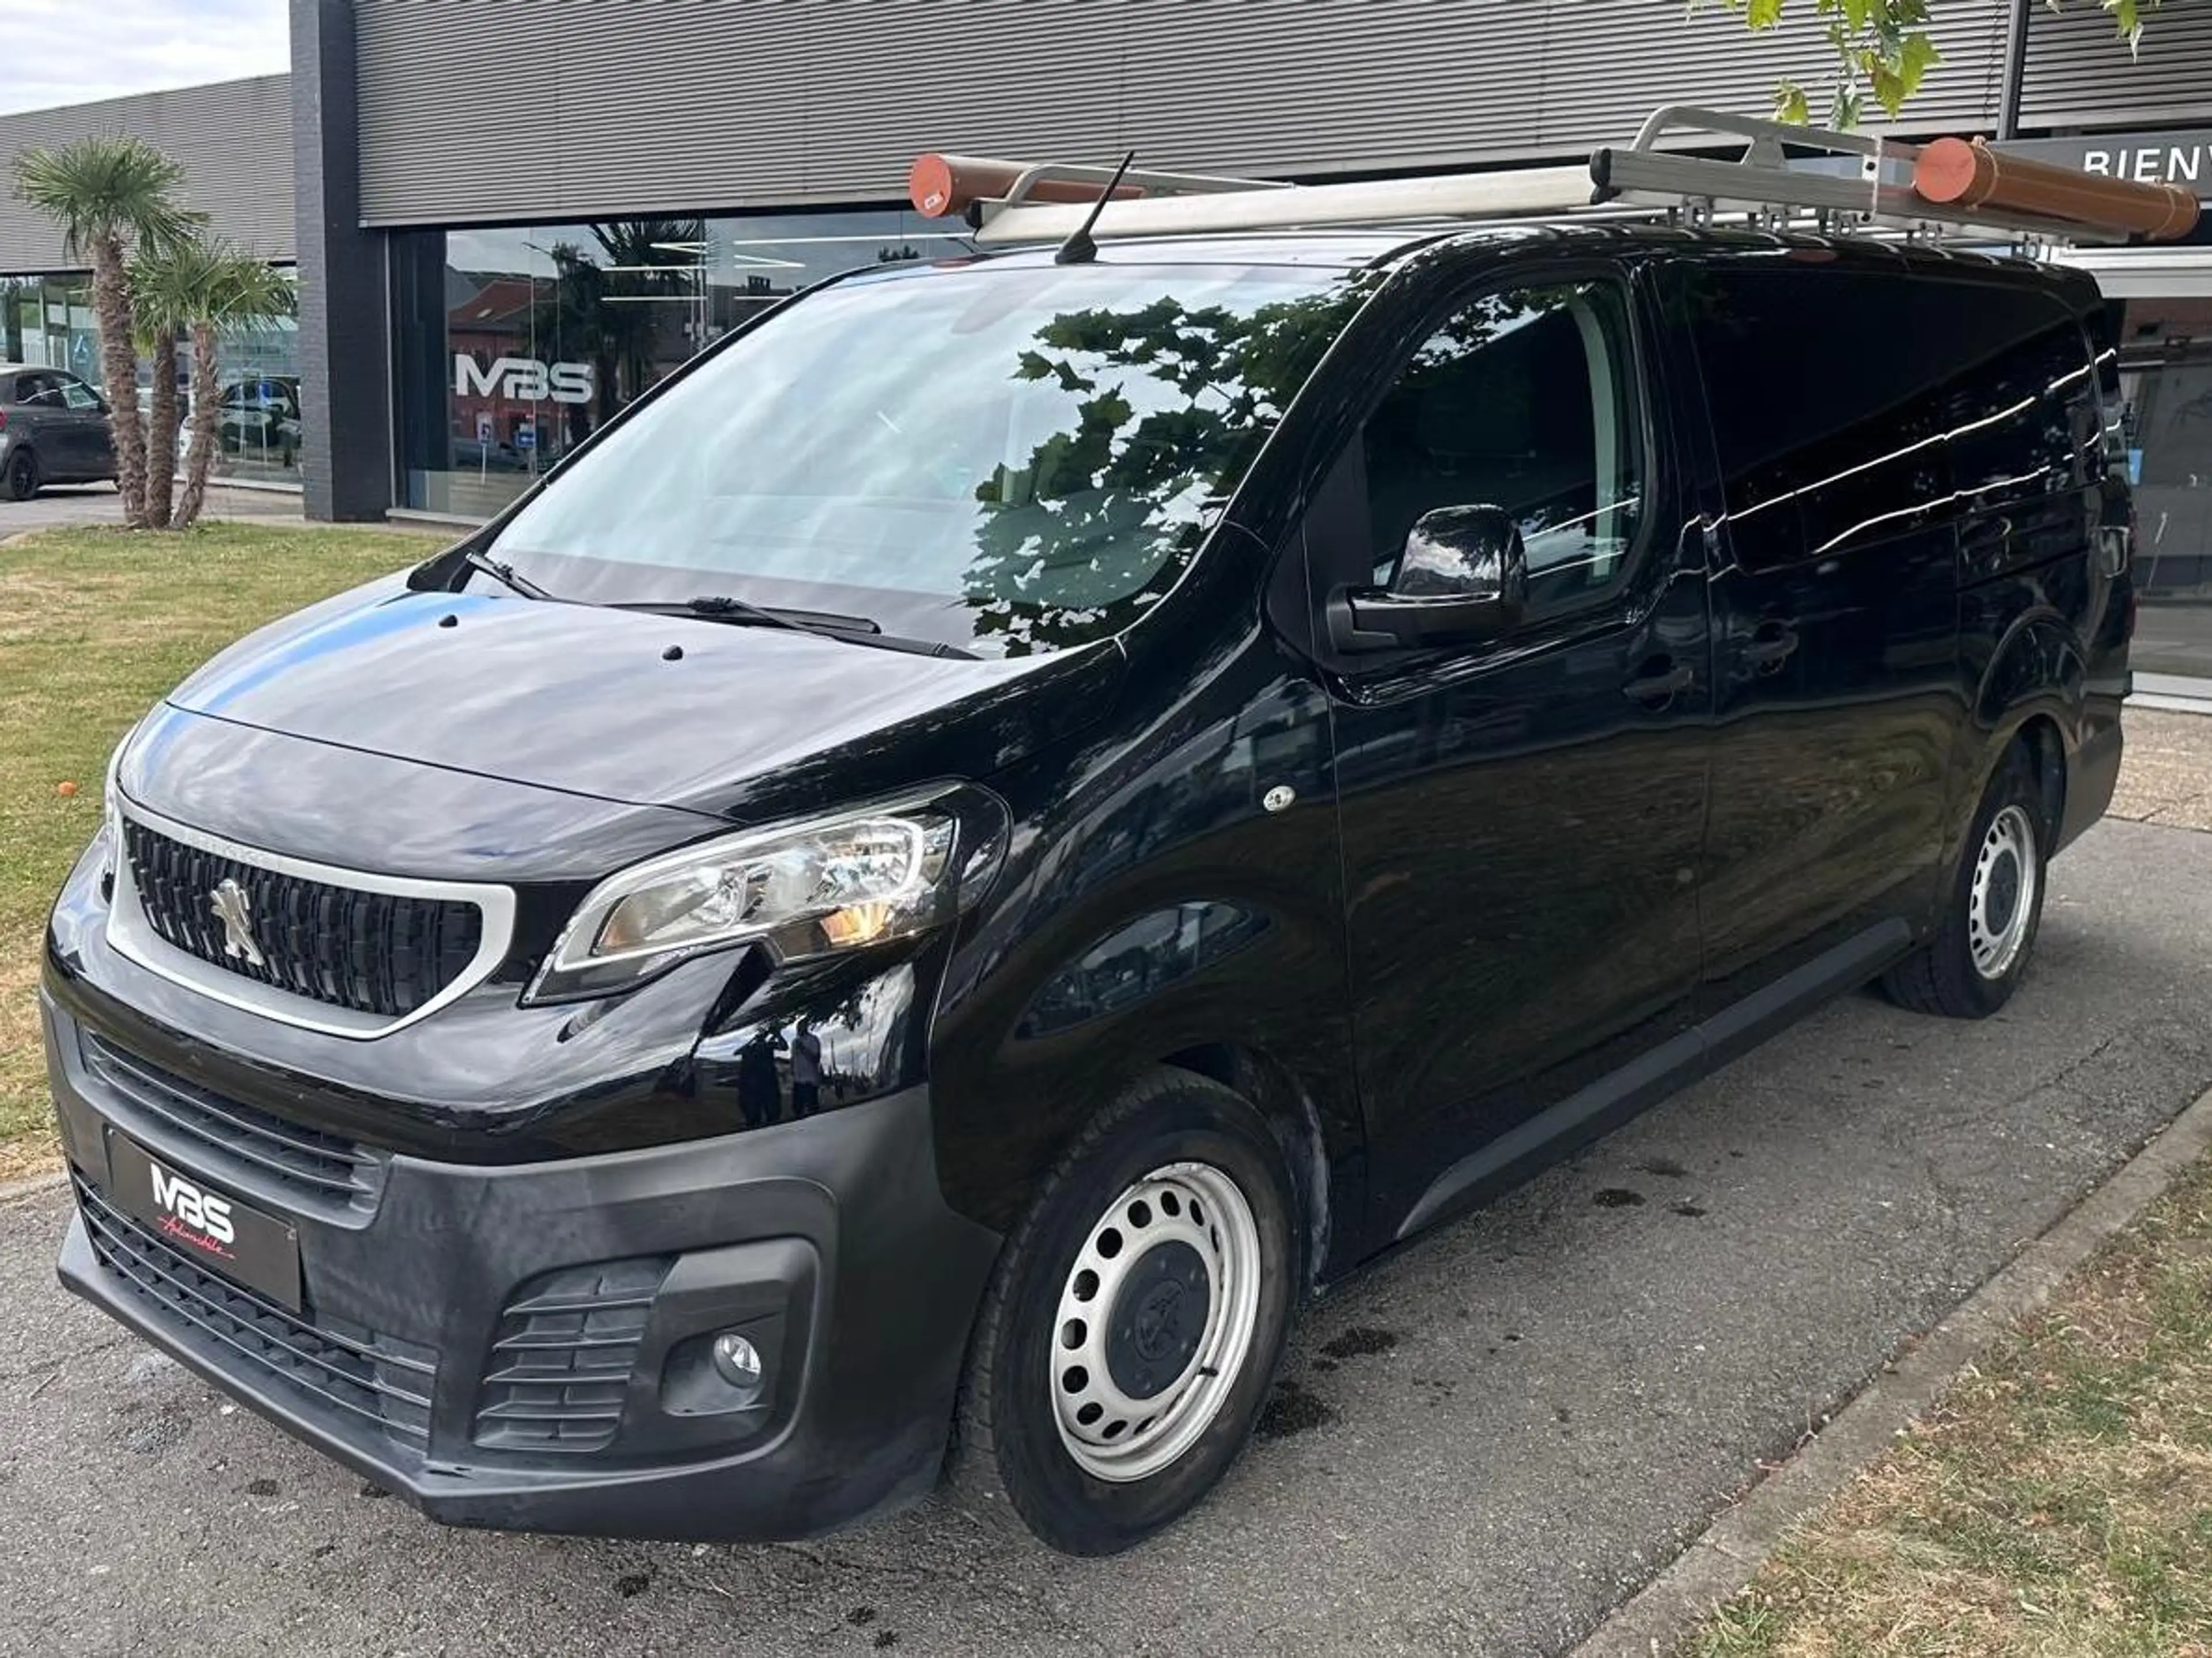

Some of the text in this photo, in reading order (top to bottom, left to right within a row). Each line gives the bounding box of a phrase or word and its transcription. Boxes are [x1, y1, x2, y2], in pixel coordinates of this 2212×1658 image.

[2084, 145, 2212, 182] BIEN
[455, 354, 593, 403] MBS
[150, 1162, 234, 1244] MBS
